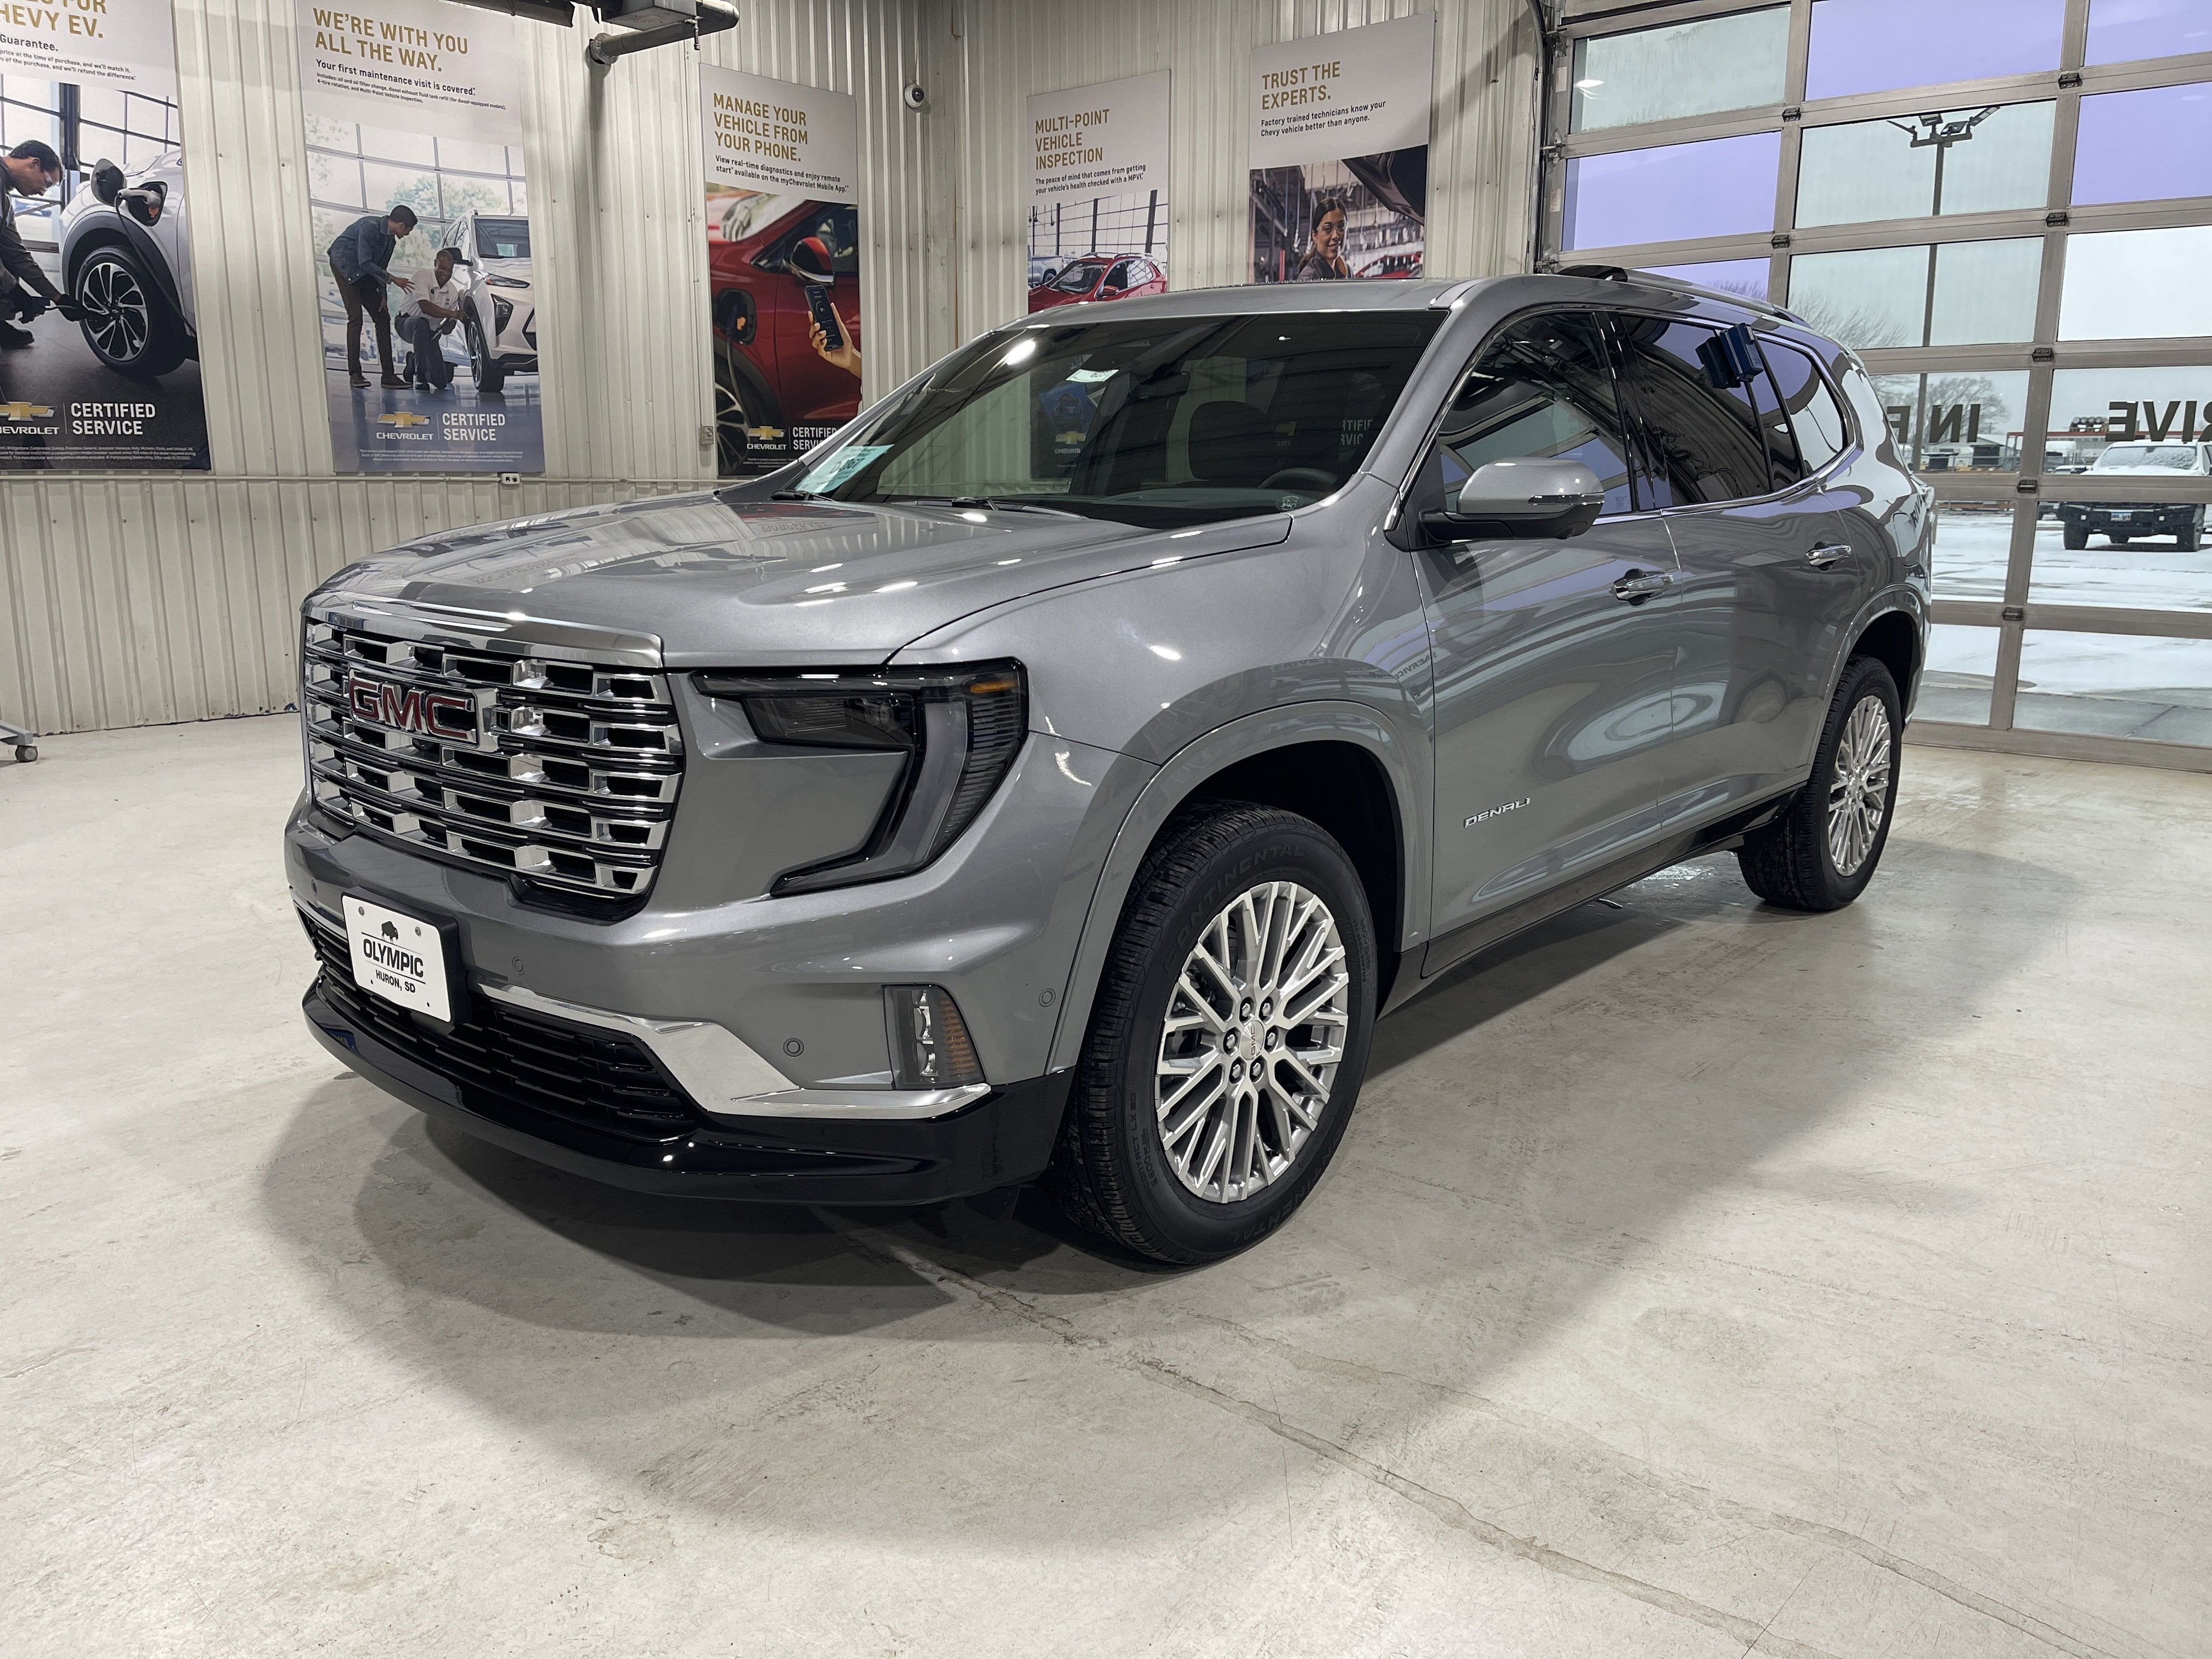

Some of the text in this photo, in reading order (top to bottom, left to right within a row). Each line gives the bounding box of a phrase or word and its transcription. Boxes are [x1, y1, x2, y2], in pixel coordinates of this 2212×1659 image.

[0, 4, 103, 38] HEVY EV.
[313, 8, 469, 54] WE'RE WITH YOU
[0, 34, 59, 52] Guarantee.
[315, 31, 442, 72] ALL THE WAY.
[316, 59, 336, 71] Your
[338, 63, 357, 75] first
[359, 69, 412, 85] maintenance
[414, 78, 432, 89] visit
[433, 81, 439, 90] is
[1262, 61, 1341, 90] TRUST THE
[1262, 84, 1331, 110] EXPERTS.
[713, 93, 806, 127] MANAGE YOUR
[1035, 109, 1110, 134] MULTI-POINT
[1261, 100, 1386, 127] Factory trained technicians know your
[713, 111, 808, 145] VEHICLE FROM
[1261, 115, 1370, 137] Chevy vehicle better than anyone.
[714, 131, 801, 162] YOUR PHONE.
[1035, 132, 1082, 152] VEHICLE
[715, 154, 730, 164] View
[731, 159, 759, 170] real-time
[760, 163, 793, 176] diagnostics
[805, 172, 820, 182] enjoy
[1036, 147, 1103, 170] INSPECTION
[734, 169, 760, 179] available
[769, 175, 780, 183] the
[780, 178, 816, 189] myChevrolet
[817, 182, 834, 191] Mobile
[1035, 187, 1047, 196] your
[1070, 180, 1087, 189] health
[1087, 178, 1109, 188] checked
[1110, 175, 1122, 184] with
[1046, 177, 1060, 185] peace
[1068, 172, 1080, 180] mind
[1126, 164, 1146, 174] getting
[71, 403, 156, 418] CERTIFIED
[442, 413, 506, 427] CERTIFIED
[0, 426, 60, 435] EVROLET
[72, 420, 143, 435] SERVICE
[376, 432, 434, 441] CHEVROLET
[443, 428, 496, 442] SERVICE
[349, 676, 477, 743] GMC
[1463, 797, 1531, 828] DENALI
[363, 938, 424, 978] OLYMPIC
[375, 969, 416, 993] HURON, SD
